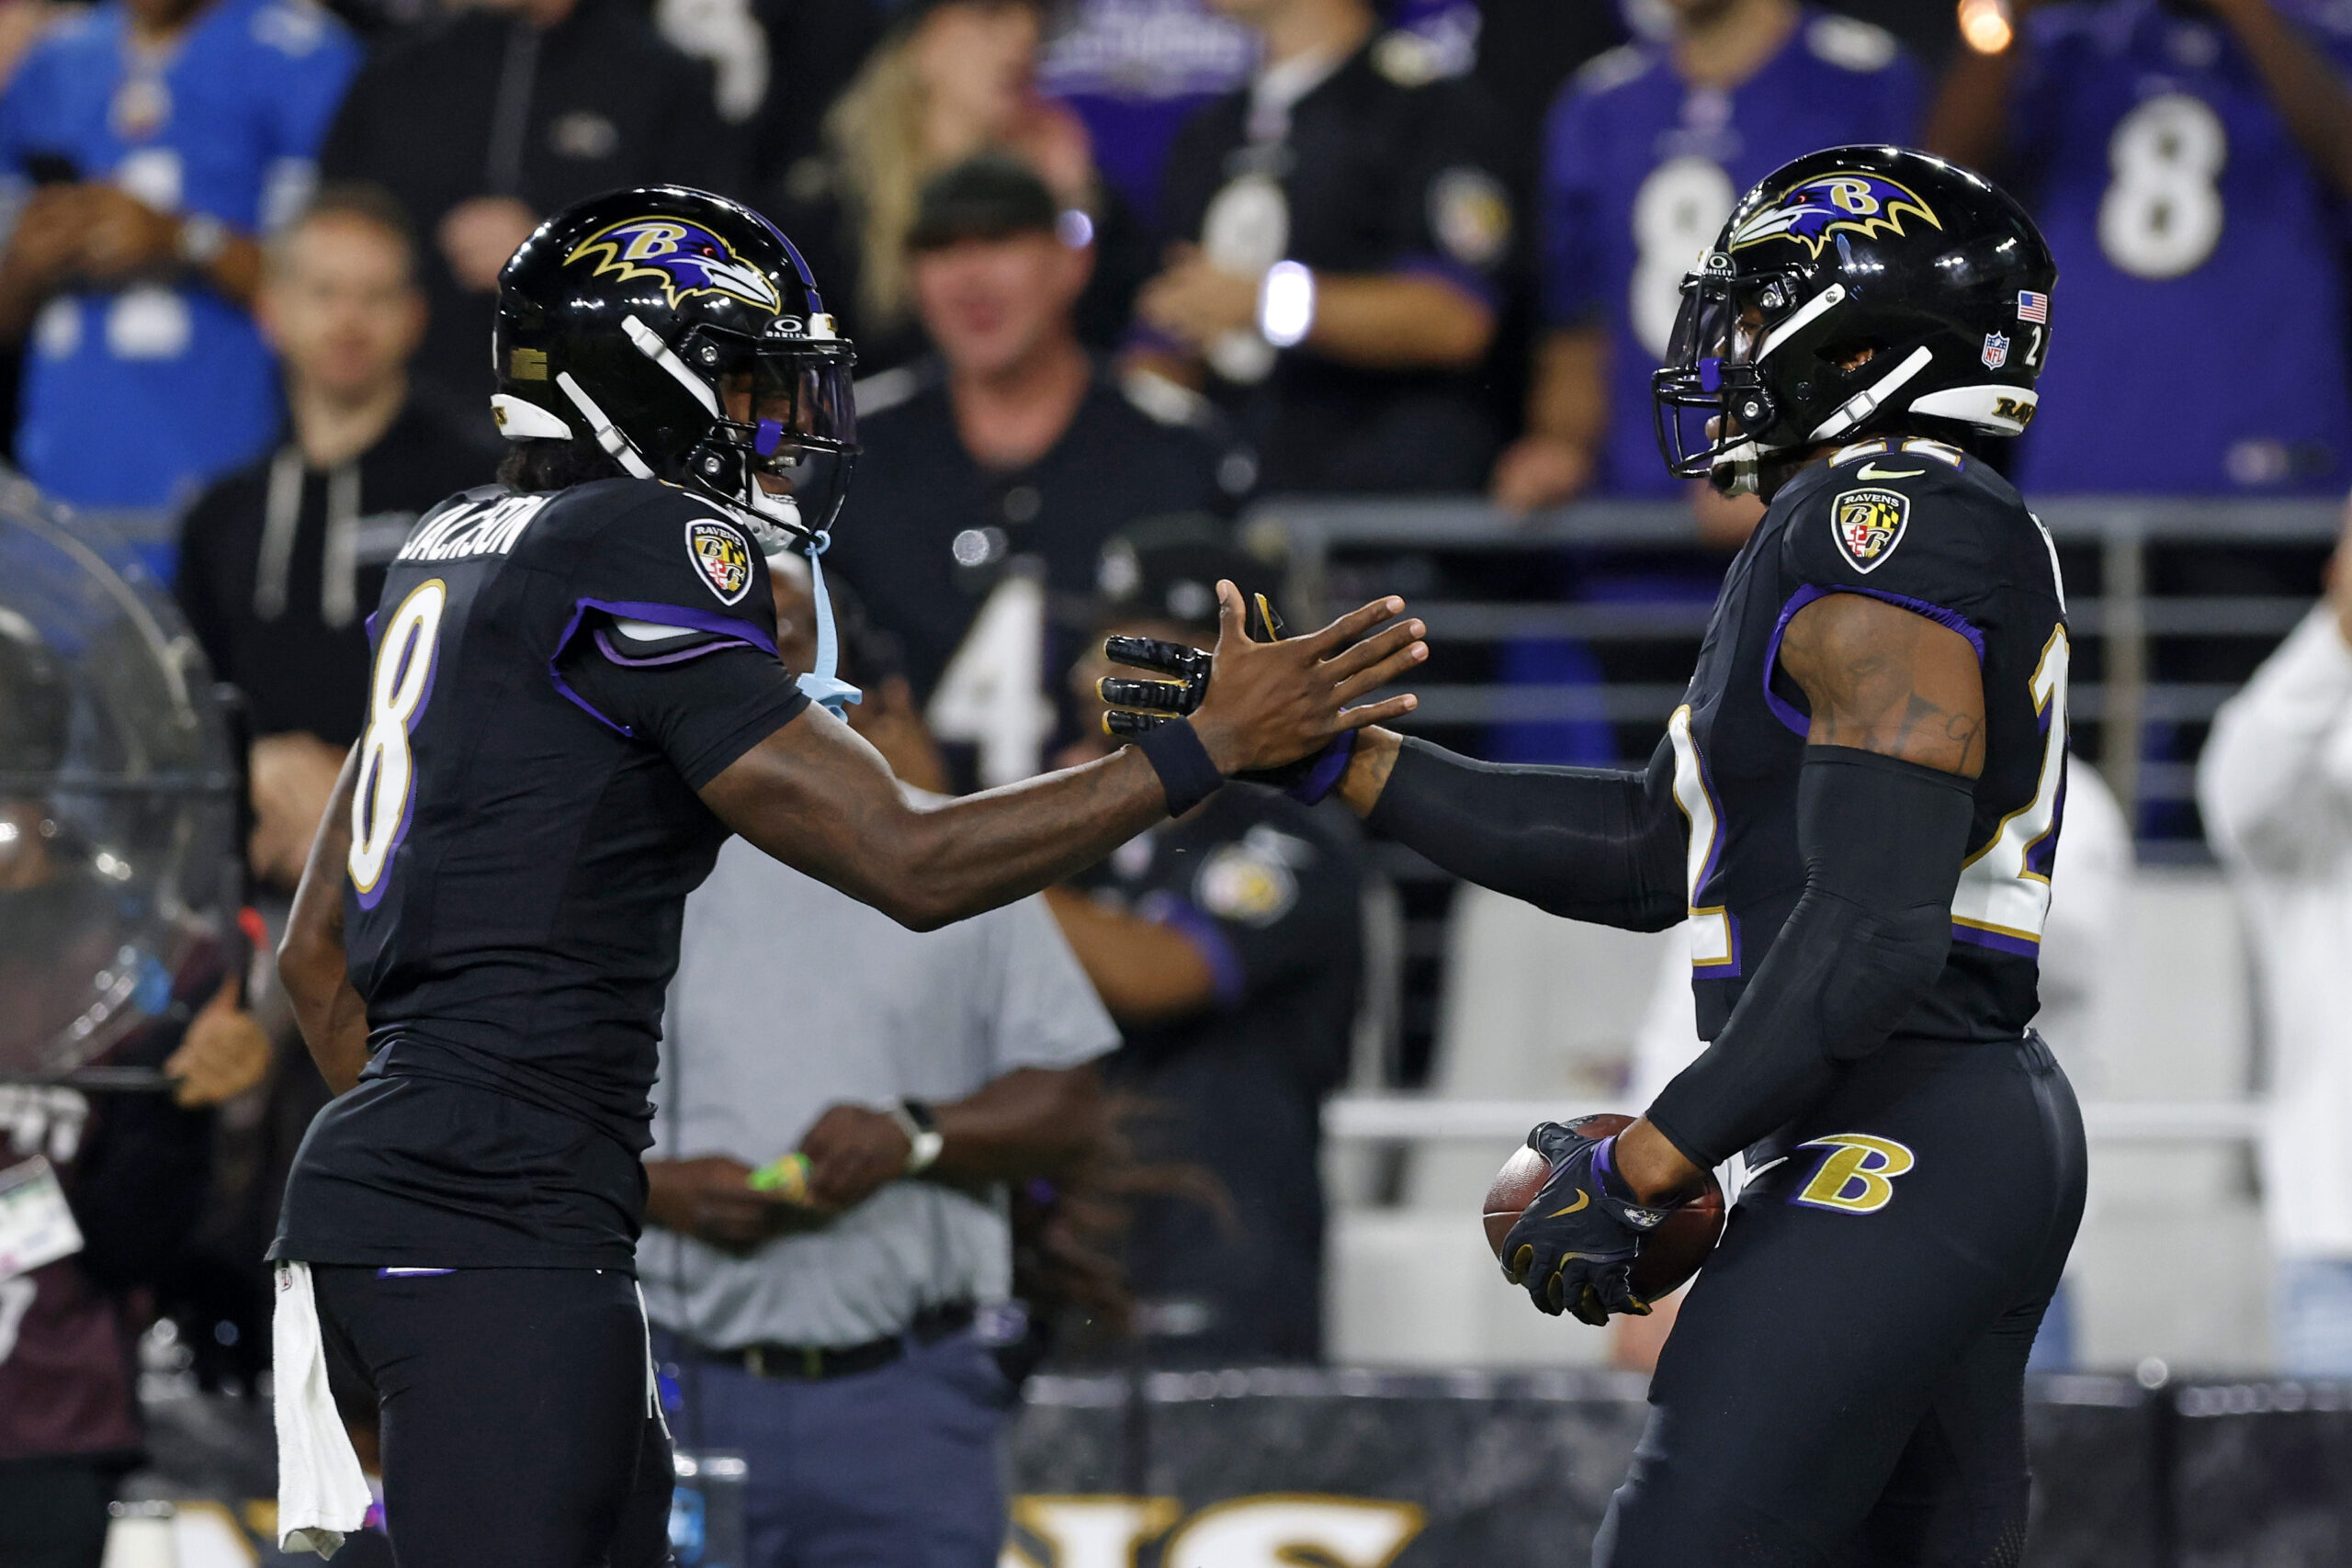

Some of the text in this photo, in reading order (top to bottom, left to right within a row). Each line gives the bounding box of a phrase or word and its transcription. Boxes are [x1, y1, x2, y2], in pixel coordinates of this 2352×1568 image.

[2098, 94, 2227, 278] 8
[1985, 346, 2003, 364] NFL
[694, 525, 742, 547] RAVENS
[1844, 494, 1900, 508] RAVENS
[926, 574, 1057, 788] 4
[348, 579, 447, 910] 8
[1788, 1131, 1917, 1215] B
